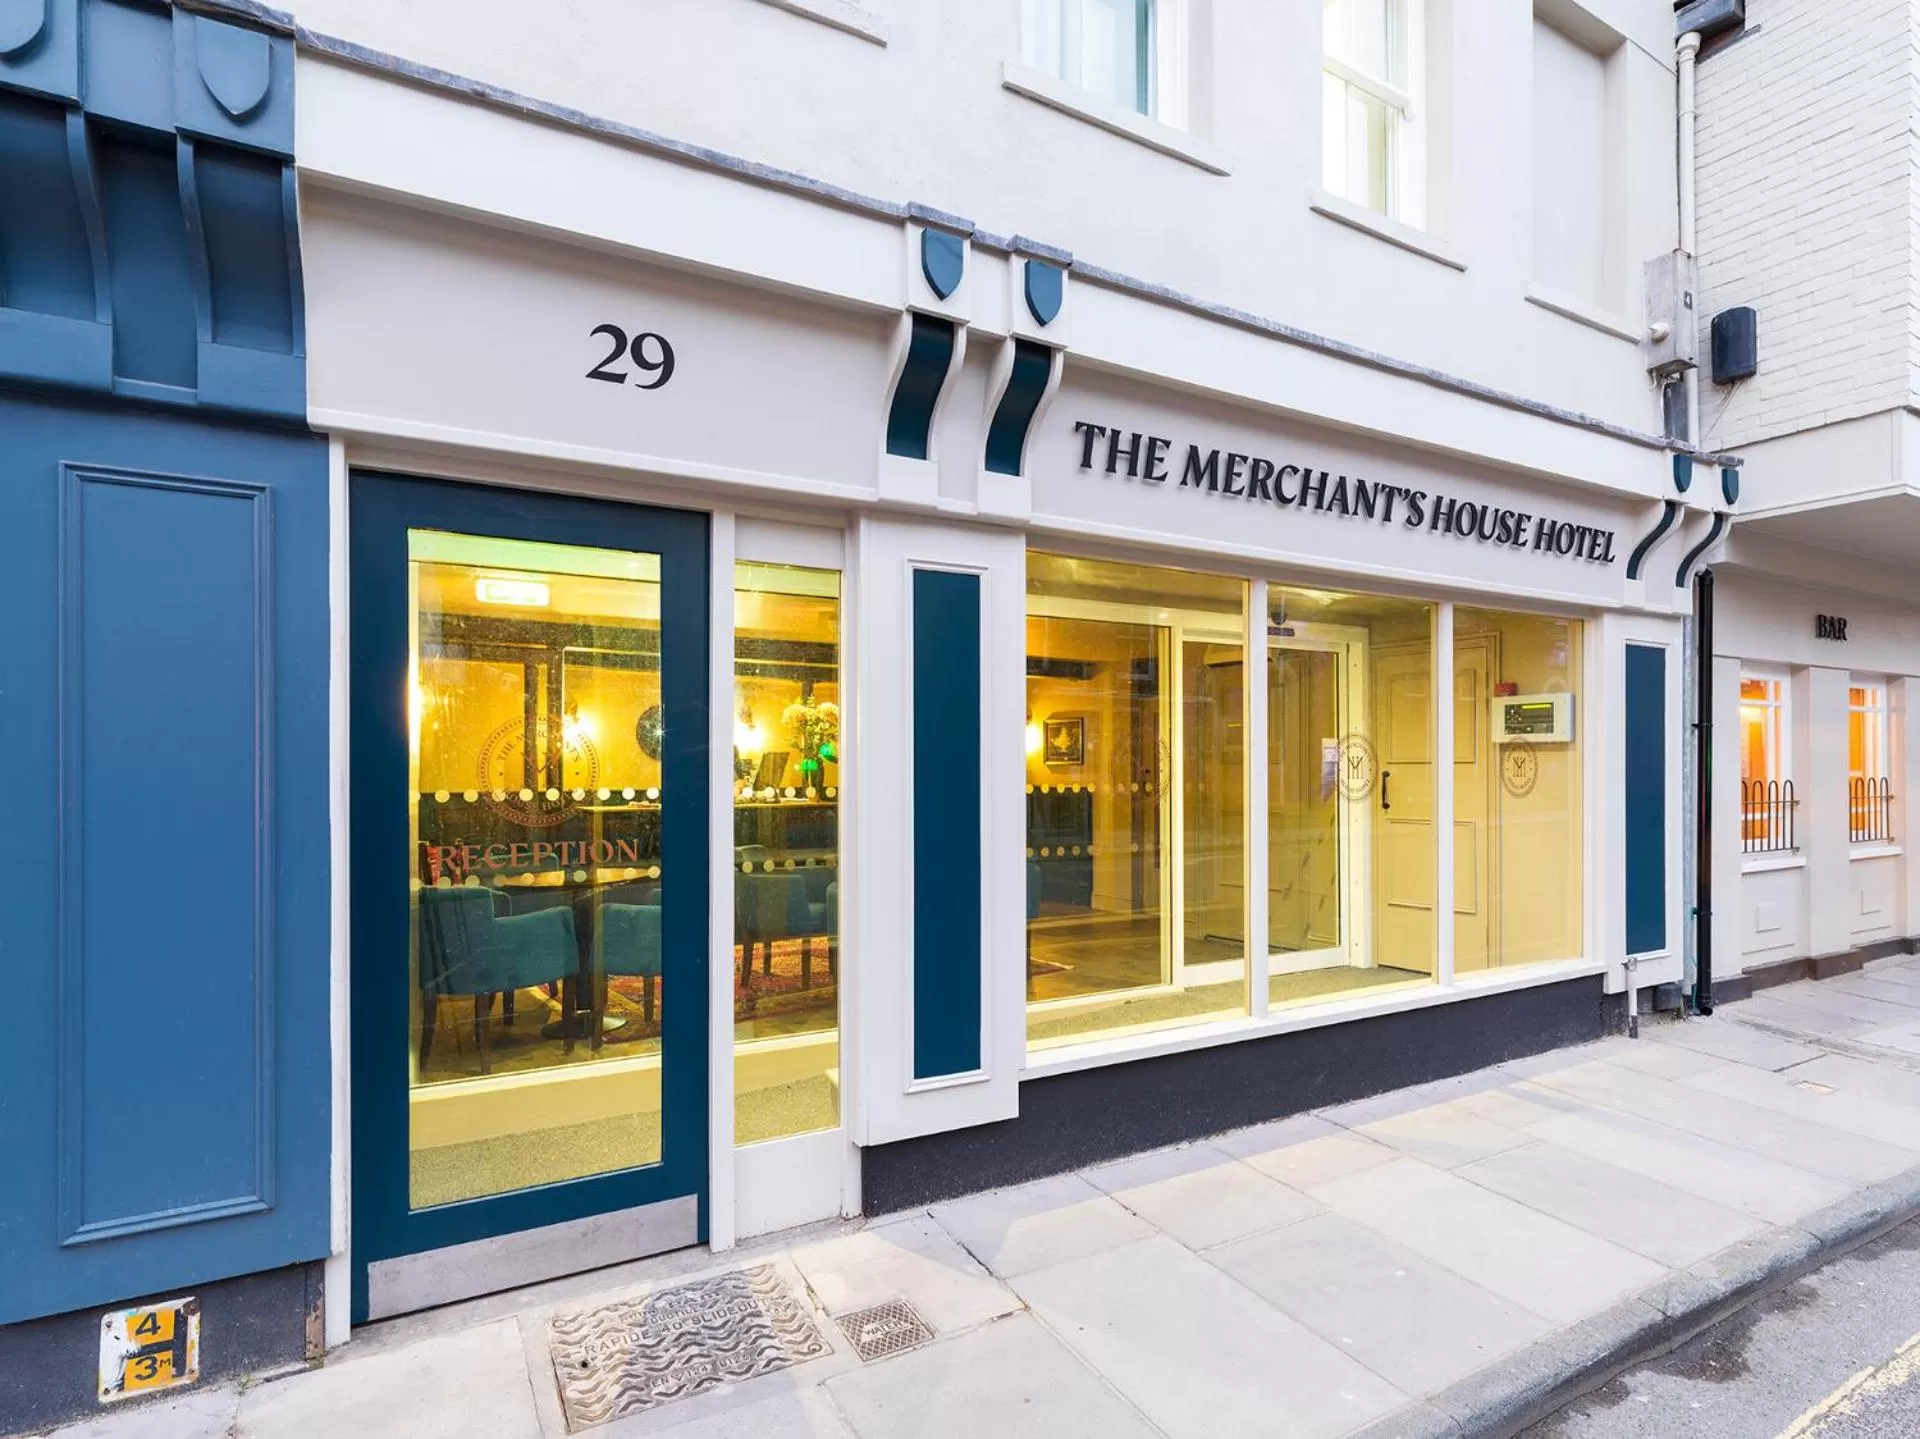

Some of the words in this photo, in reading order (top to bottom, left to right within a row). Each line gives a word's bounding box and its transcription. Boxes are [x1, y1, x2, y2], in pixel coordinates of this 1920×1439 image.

[585, 323, 675, 389] 29
[1074, 421, 1172, 482] THE
[1431, 495, 1532, 547] HOUSE
[1534, 518, 1615, 563] HOTEL
[1815, 614, 1848, 641] BAR
[437, 839, 639, 873] RECEPTION
[135, 1311, 161, 1336] 4
[584, 1328, 652, 1354] RAPIDE
[661, 1322, 684, 1335] 40
[866, 1319, 908, 1337] WATER
[651, 1376, 670, 1389] EN
